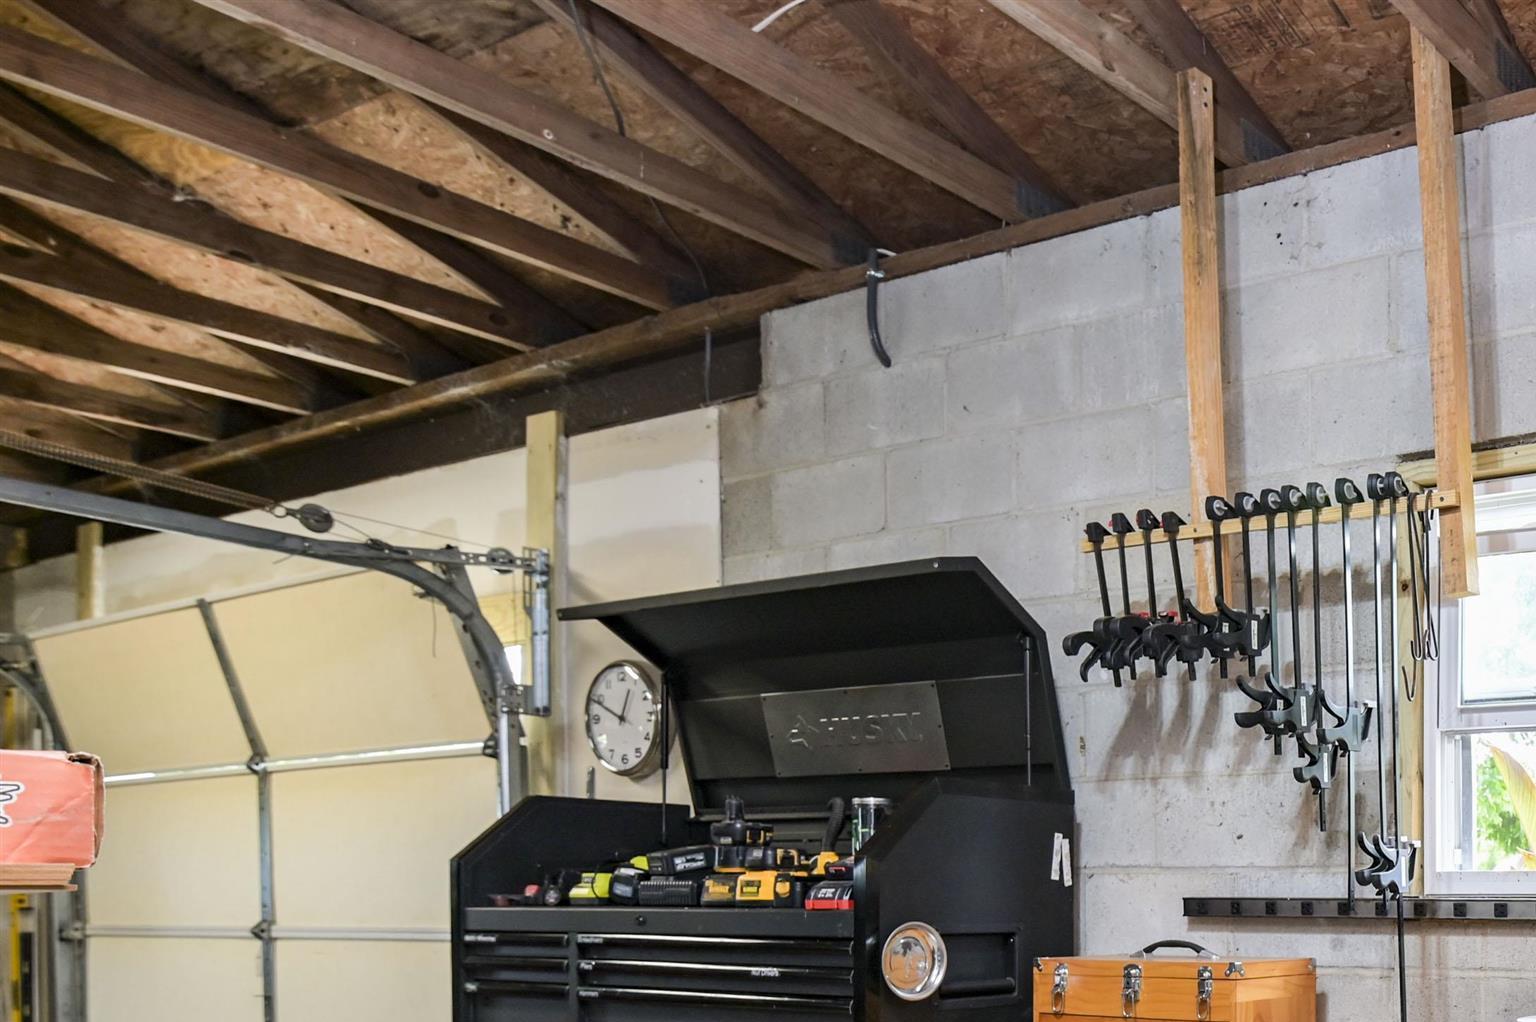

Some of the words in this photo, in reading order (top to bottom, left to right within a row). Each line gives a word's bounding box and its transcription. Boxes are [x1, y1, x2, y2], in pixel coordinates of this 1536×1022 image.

[592, 714, 601, 725] 9
[643, 732, 651, 741] 4
[609, 748, 615, 760] 7
[621, 753, 629, 765] 6
[634, 747, 642, 759] 5
